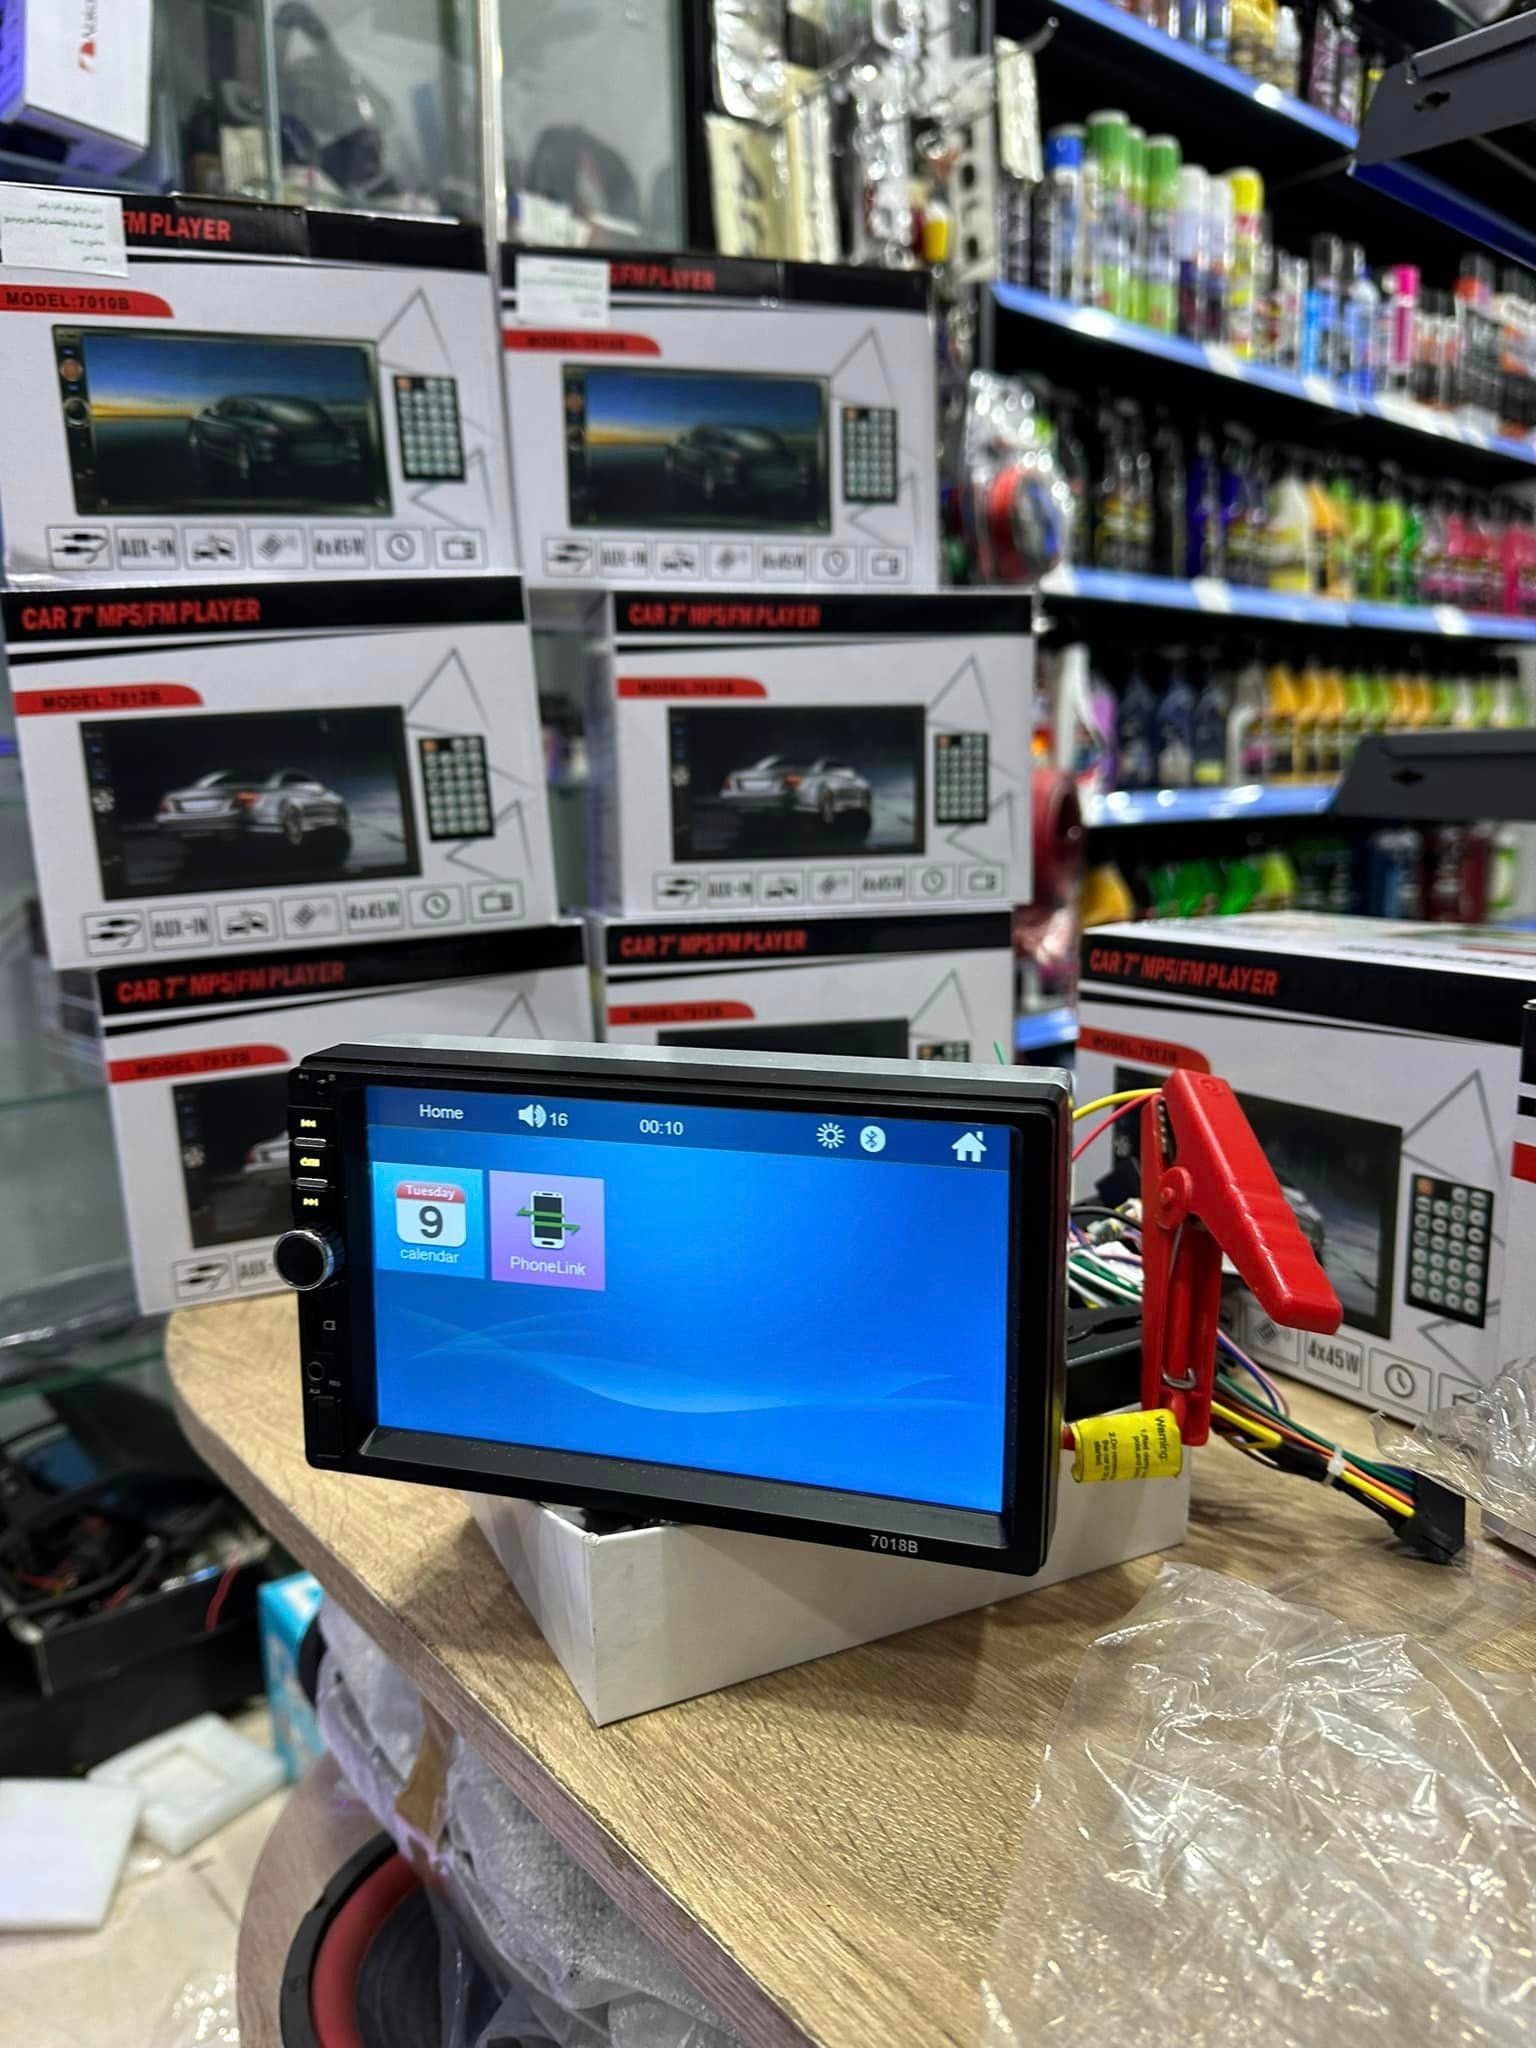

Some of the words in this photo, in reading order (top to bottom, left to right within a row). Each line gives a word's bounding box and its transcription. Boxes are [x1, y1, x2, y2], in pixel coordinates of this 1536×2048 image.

[150, 212, 232, 242] PLAYER
[645, 265, 715, 291] PLAYER
[21, 605, 67, 631] CAR
[180, 597, 261, 624] PLAYER
[628, 603, 666, 626] CAR
[755, 603, 821, 628] PLAYER
[620, 934, 657, 957] CAR
[742, 928, 808, 952] PLAYER
[116, 979, 161, 1005] CAR
[268, 960, 346, 990] PLAYER
[1089, 948, 1122, 975] CAR
[1206, 961, 1280, 996] PLAYER
[419, 1103, 464, 1120] Home
[550, 1112, 568, 1127] 16
[639, 1119, 684, 1136] 00:10
[405, 1184, 456, 1201] Tuesday
[418, 1206, 444, 1239] 9
[400, 1247, 460, 1264] calendar
[510, 1255, 586, 1277] PhoneLink
[1308, 1341, 1360, 1374] 4x45W
[869, 1535, 918, 1553] 7018B
